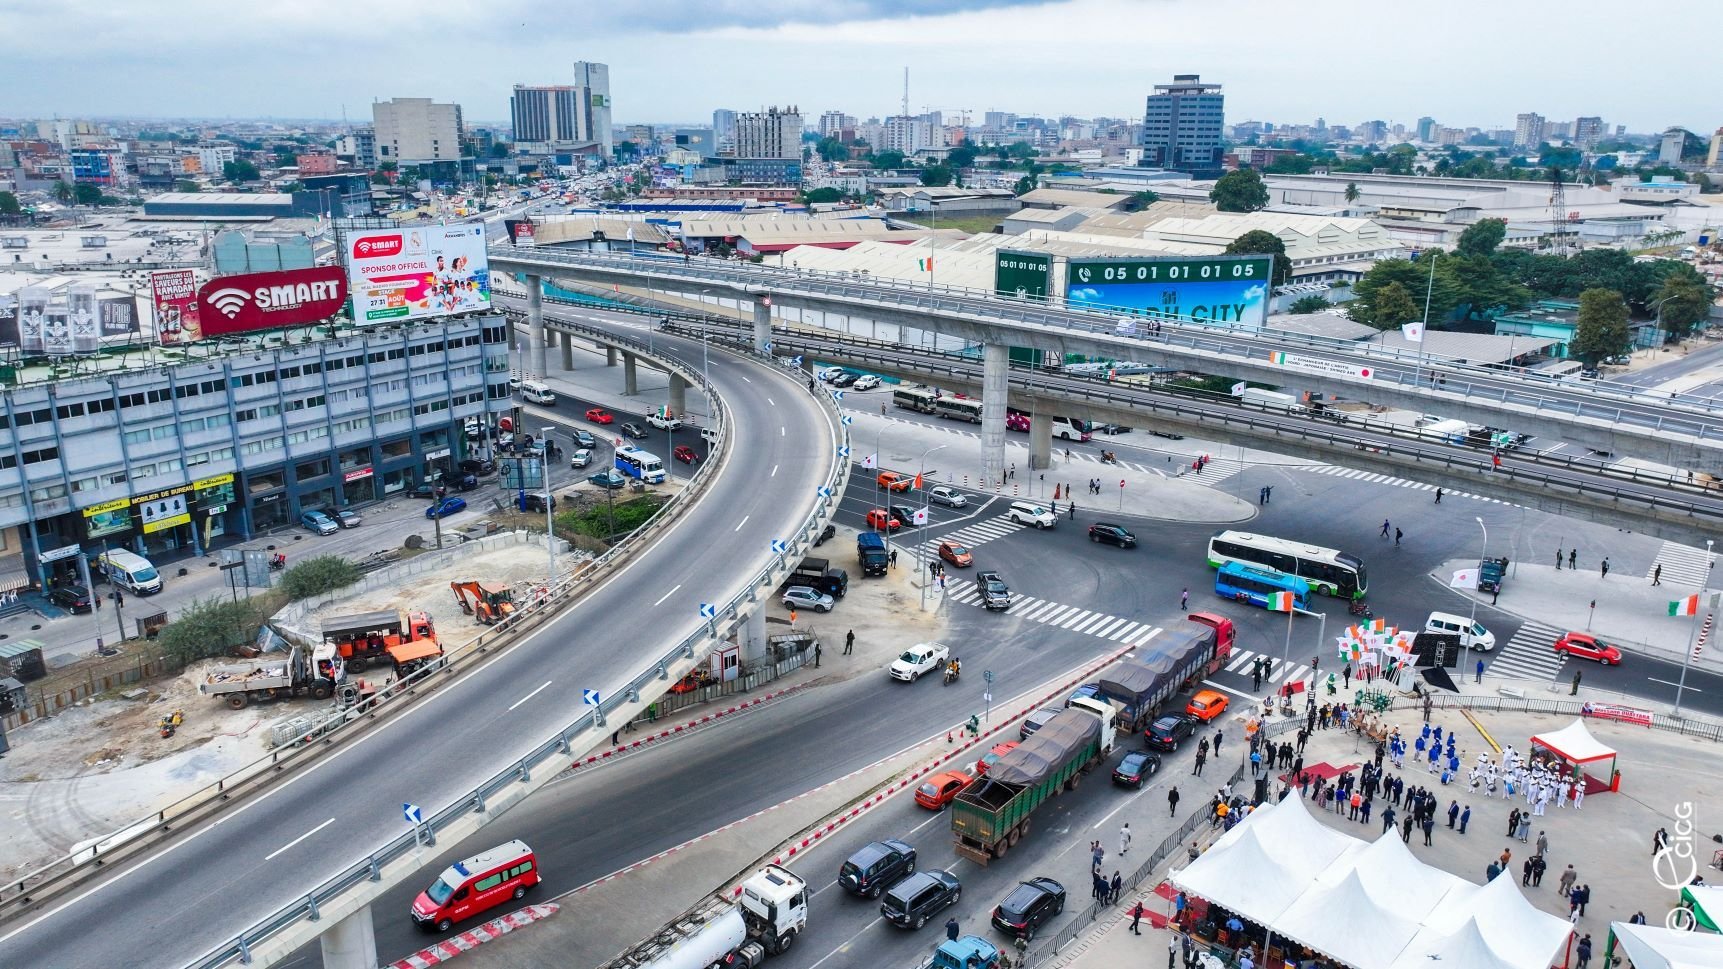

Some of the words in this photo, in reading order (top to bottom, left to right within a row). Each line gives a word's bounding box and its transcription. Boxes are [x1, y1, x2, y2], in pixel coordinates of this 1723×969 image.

[372, 240, 399, 249] SMART
[361, 264, 396, 274] SPONSOR
[398, 261, 427, 270] OFFICIEL
[1104, 268, 1127, 280] 05
[1137, 266, 1157, 279] 01
[1169, 266, 1189, 279] 01
[1200, 265, 1221, 278] 01
[1232, 264, 1253, 277] 05
[155, 279, 183, 288] SAVEURS
[156, 284, 194, 296] RAMADAN
[255, 280, 339, 308] SMART
[104, 304, 110, 323] 3
[112, 303, 131, 323] FOIS
[261, 303, 303, 312] TECHNOLOGY
[1191, 304, 1246, 324] CITY
[131, 492, 160, 504] MOBILIER
[170, 485, 194, 496] BUREAU
